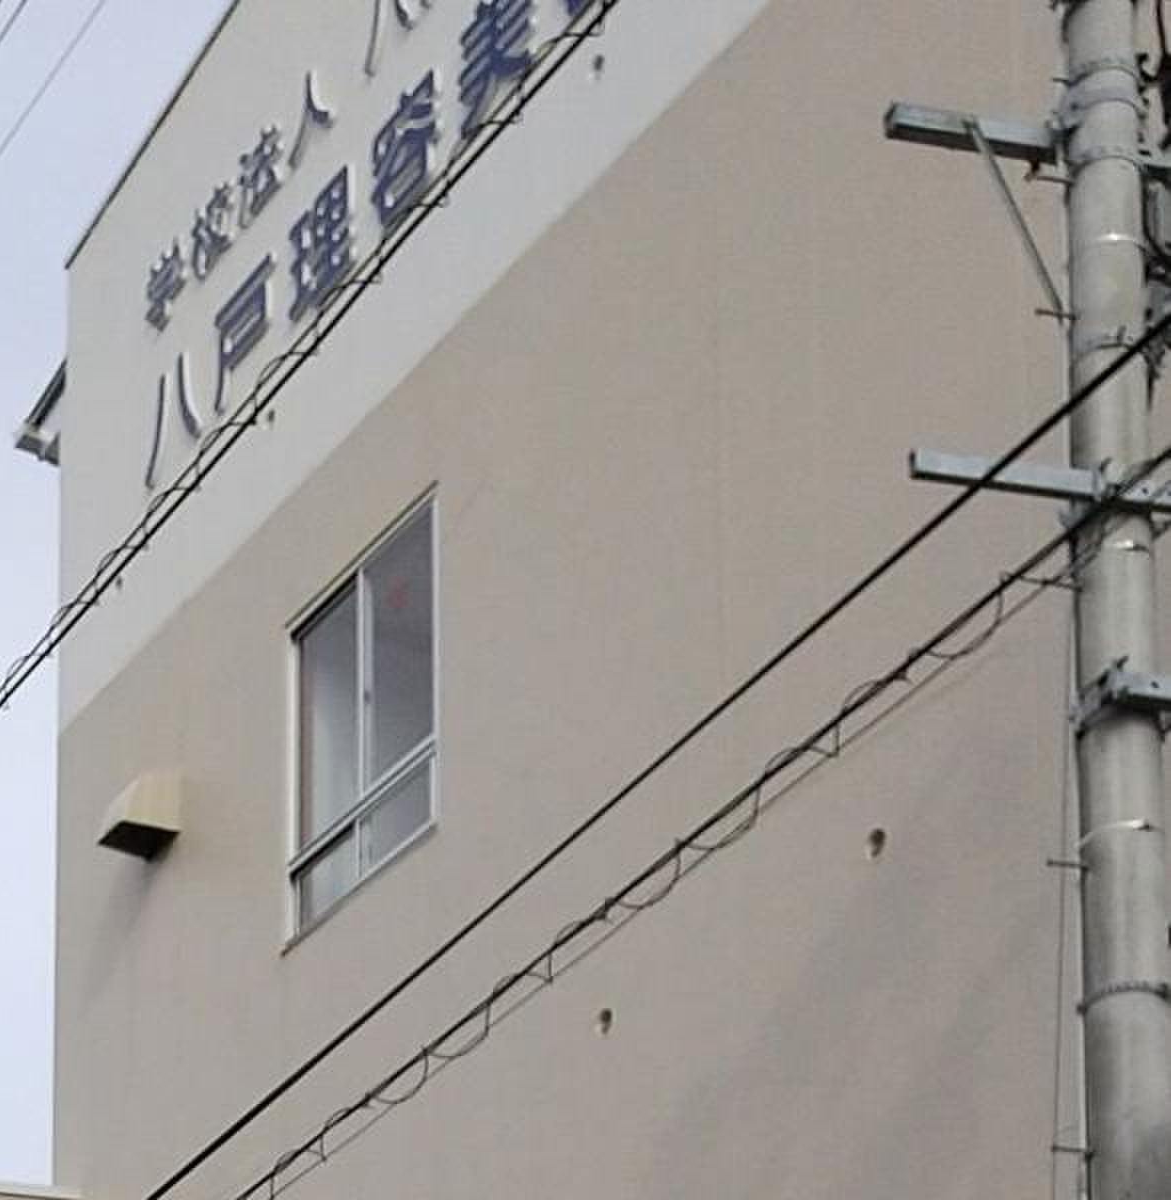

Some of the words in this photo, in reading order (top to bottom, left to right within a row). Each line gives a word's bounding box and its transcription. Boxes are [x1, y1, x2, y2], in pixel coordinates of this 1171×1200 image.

[144, 69, 332, 332] 学校法人
[145, 0, 584, 489] 八戸理容美
